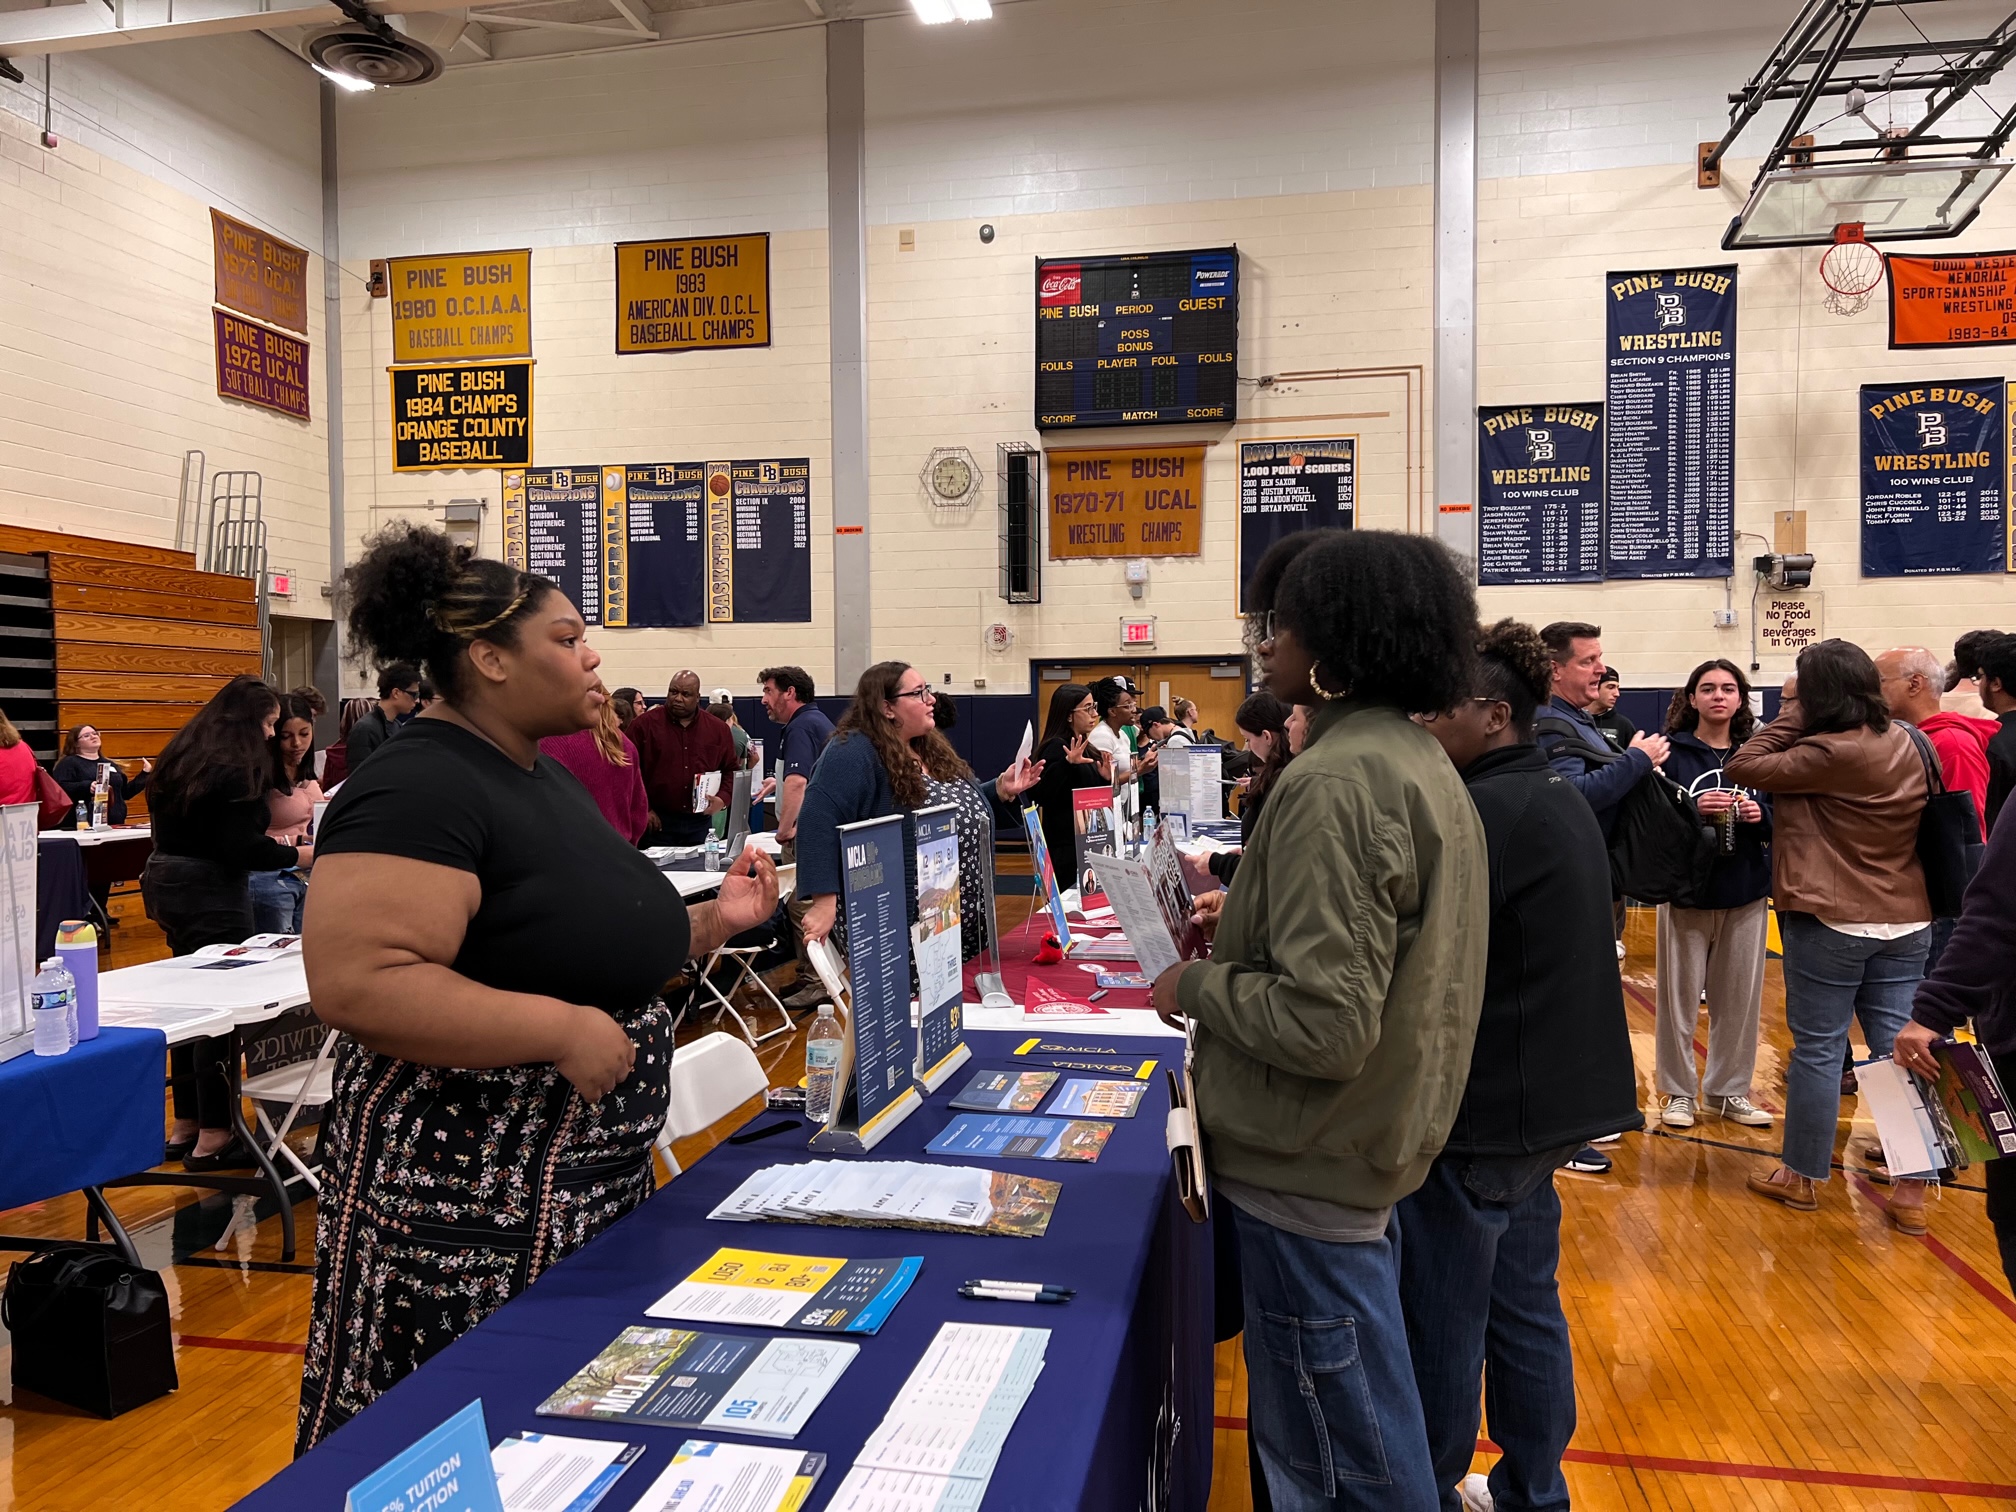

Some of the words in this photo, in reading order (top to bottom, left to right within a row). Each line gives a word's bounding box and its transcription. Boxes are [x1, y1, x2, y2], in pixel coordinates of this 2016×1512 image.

[223, 222, 257, 257] PINE
[263, 240, 300, 275] BUSH
[644, 248, 684, 271] PINE
[691, 244, 738, 270] BUSH
[223, 251, 259, 283] 1973
[264, 266, 300, 298] UCAL
[406, 268, 447, 290] PINE
[463, 263, 512, 286] BUSH
[1195, 270, 1230, 280] POWERADE
[1948, 270, 2008, 284] MEMORIAL
[676, 273, 706, 294] 1983
[1611, 272, 1663, 301] PINE
[1674, 270, 1731, 295] BUSH
[1903, 284, 2006, 299] SPORTSMANSHIP
[395, 298, 437, 320] 1980
[446, 294, 528, 317] O.C.I.A.A.
[627, 298, 689, 320] AMERICAN
[693, 296, 716, 316] DIV.
[1040, 307, 1063, 319] PINE
[1069, 305, 1099, 318] BUSH
[1115, 304, 1154, 315] PERIOD
[1179, 297, 1226, 312] GUEST
[1943, 298, 2013, 313] WRESTLING
[409, 327, 464, 349] BASEBALL
[470, 324, 514, 346] CHAMPS
[630, 322, 697, 344] BASEBALL
[702, 319, 755, 341] CHAMPS
[1120, 329, 1150, 340] POSS
[1948, 326, 2008, 340] 1983-84
[224, 317, 259, 349] PINE
[264, 332, 302, 365] BUSH
[1117, 342, 1153, 353] BONUS
[1619, 331, 1722, 351] WRESTLING
[225, 343, 262, 374] 1972
[266, 357, 304, 389] UCAL
[1040, 361, 1073, 371] FOULS
[1097, 358, 1137, 369] PLAYER
[1151, 356, 1179, 366] FOUL
[1198, 353, 1233, 364] FOULS
[1610, 357, 1656, 366] SECTION
[1657, 356, 1665, 364] 9
[1666, 352, 1731, 364] CHAMPIONS
[225, 367, 272, 400] SOFTBALL
[274, 383, 307, 412] CHAMPS
[417, 373, 454, 393] PINE
[460, 370, 505, 391] BUSH
[405, 397, 444, 417] 1984
[450, 394, 518, 415] CHAMPS
[1186, 407, 1224, 418] SCORE
[1869, 389, 1926, 420] PINE
[1930, 388, 1996, 415] BUSH
[1122, 411, 1158, 420] MATCH
[1483, 407, 1533, 436] PINE
[1544, 406, 1599, 432] BUSH
[397, 420, 456, 440] ORANGE
[462, 416, 527, 438] COUNTY
[419, 441, 503, 462] BASEBALL
[1243, 445, 1274, 464] BOYS
[1275, 441, 1352, 460] BASKETBALL
[1067, 460, 1112, 481] PINE
[1131, 457, 1185, 479] BUSH
[1243, 467, 1270, 477] 1,000
[1271, 465, 1303, 476] POINT
[1304, 463, 1352, 474] SCORERS
[1874, 452, 1990, 471] WRESTLING
[526, 476, 548, 485] PINE
[574, 475, 598, 483] BUSH
[627, 472, 649, 481] PINE
[678, 470, 703, 479] BUSH
[783, 468, 808, 476] BUSH
[1491, 466, 1591, 485] WRESTLING
[735, 479, 806, 496] CHAMPIONS
[1275, 478, 1296, 486] SAXON
[1337, 476, 1352, 484] 1182
[1337, 485, 1352, 493] 1104
[1890, 478, 1908, 486] 100
[1911, 477, 1941, 485] WINS
[1942, 476, 1974, 484] CLUB
[528, 486, 597, 503] CHAMPIONS
[629, 485, 702, 503] CHAMPIONS
[735, 498, 760, 506] SECTION
[761, 497, 769, 505] IX
[789, 496, 806, 505] 2000
[1053, 491, 1125, 514] 1970-71
[1144, 489, 1197, 511] UCAL
[1260, 496, 1291, 504] BRANDON
[1291, 494, 1317, 503] POWELL
[1337, 493, 1352, 501] 1357
[1502, 491, 1520, 499] 100
[1522, 490, 1549, 498] WINS
[1550, 489, 1579, 497] CLUB
[1243, 505, 1257, 513] 2018
[1260, 504, 1283, 513] BRYAN
[1283, 503, 1308, 511] POWELL
[1337, 502, 1352, 510] 1099
[506, 494, 524, 569] EBALL
[1068, 523, 1125, 545] WRESTLING
[1141, 521, 1183, 543] CHAMPS
[607, 502, 624, 622] BASEBALL
[711, 498, 730, 619] BASKETBALL
[1771, 601, 1805, 610] Please
[1766, 611, 1780, 619] No
[1784, 610, 1811, 619] Food
[1128, 623, 1149, 641] EXIT
[1781, 620, 1794, 628] Or
[1762, 628, 1816, 638] Beverages
[1771, 638, 1780, 646] In
[1784, 638, 1808, 648] Gym
[847, 844, 867, 869] MCLA
[1067, 1046, 1117, 1054] MCLA
[1051, 1061, 1107, 1069] MCLA
[592, 1373, 661, 1413] MCLA
[721, 1399, 758, 1419] 105
[405, 1452, 462, 1504] TUITION
